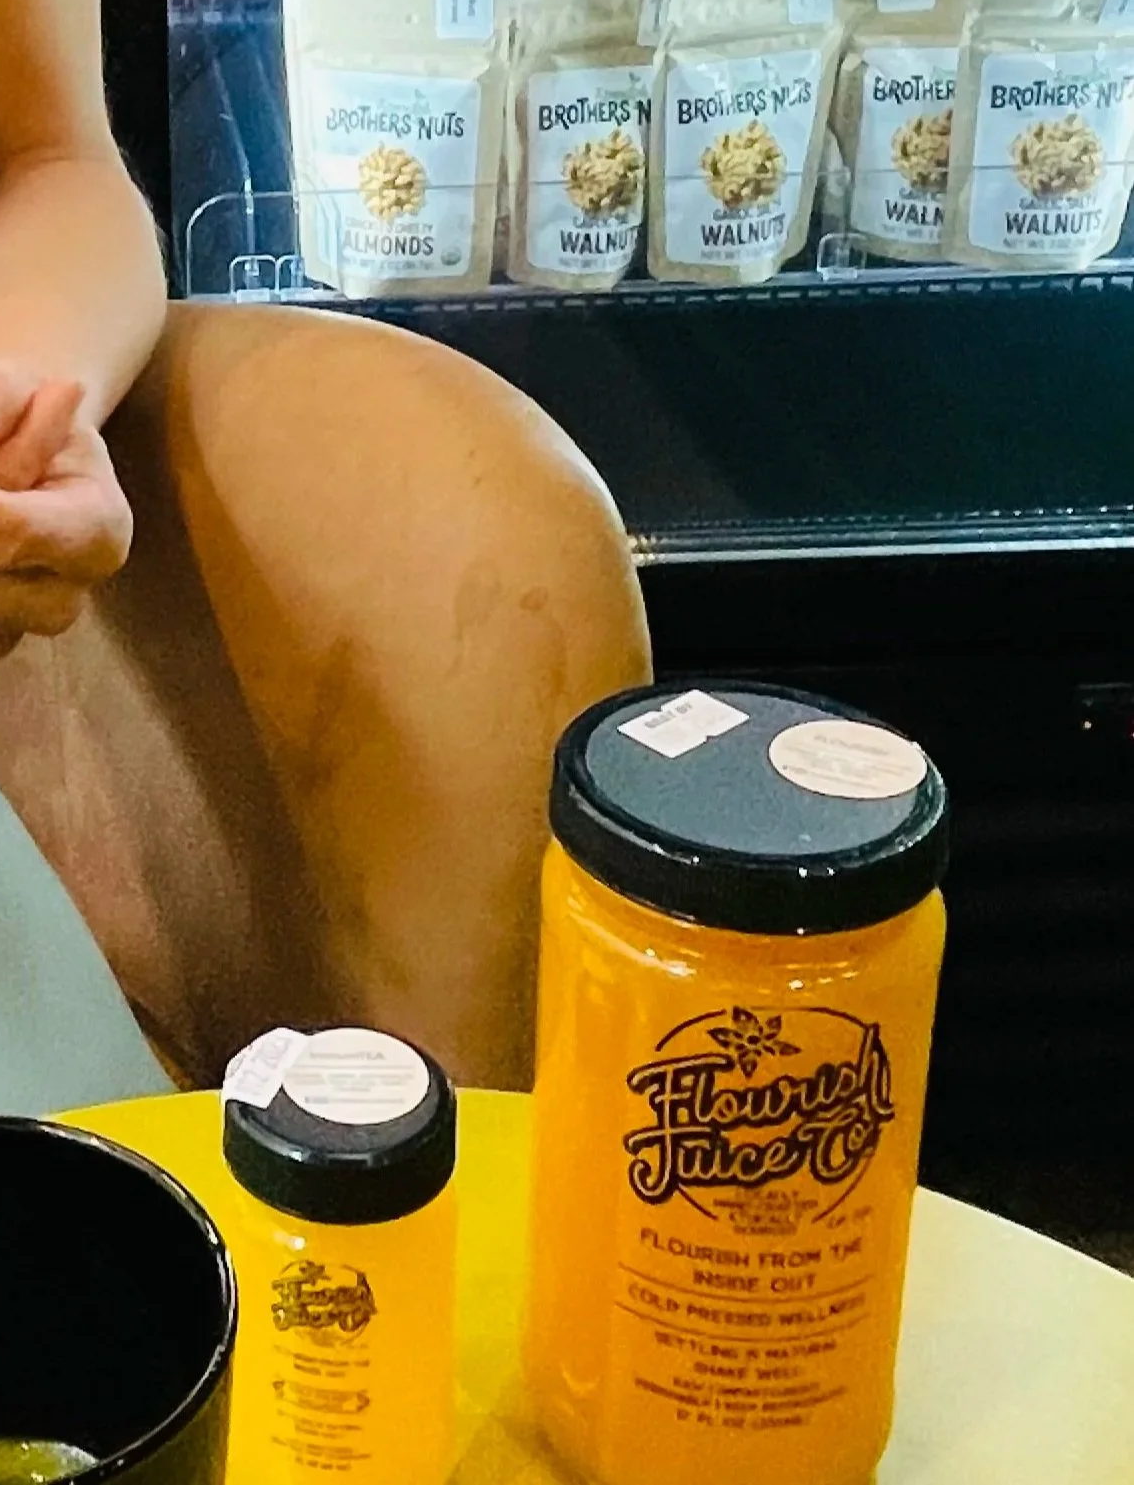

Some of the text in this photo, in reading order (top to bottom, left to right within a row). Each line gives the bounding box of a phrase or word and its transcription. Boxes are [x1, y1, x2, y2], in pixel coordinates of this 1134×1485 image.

[677, 87, 768, 124] BROTHERS
[770, 77, 812, 115] NUTS
[873, 75, 955, 105] BROTHER
[990, 75, 1134, 111] BROTHERS NUT
[326, 105, 466, 141] BROTHERS NUTS
[538, 97, 631, 131] BROTHERS
[885, 199, 944, 226] WALN
[1004, 208, 1102, 235] WALNUTS
[343, 229, 434, 256] ALMONDS
[640, 1227, 751, 1267] FLOURISH
[758, 1248, 822, 1269] FROM
[693, 1268, 816, 1293] INSIDE OUT
[627, 1283, 681, 1313] COLD
